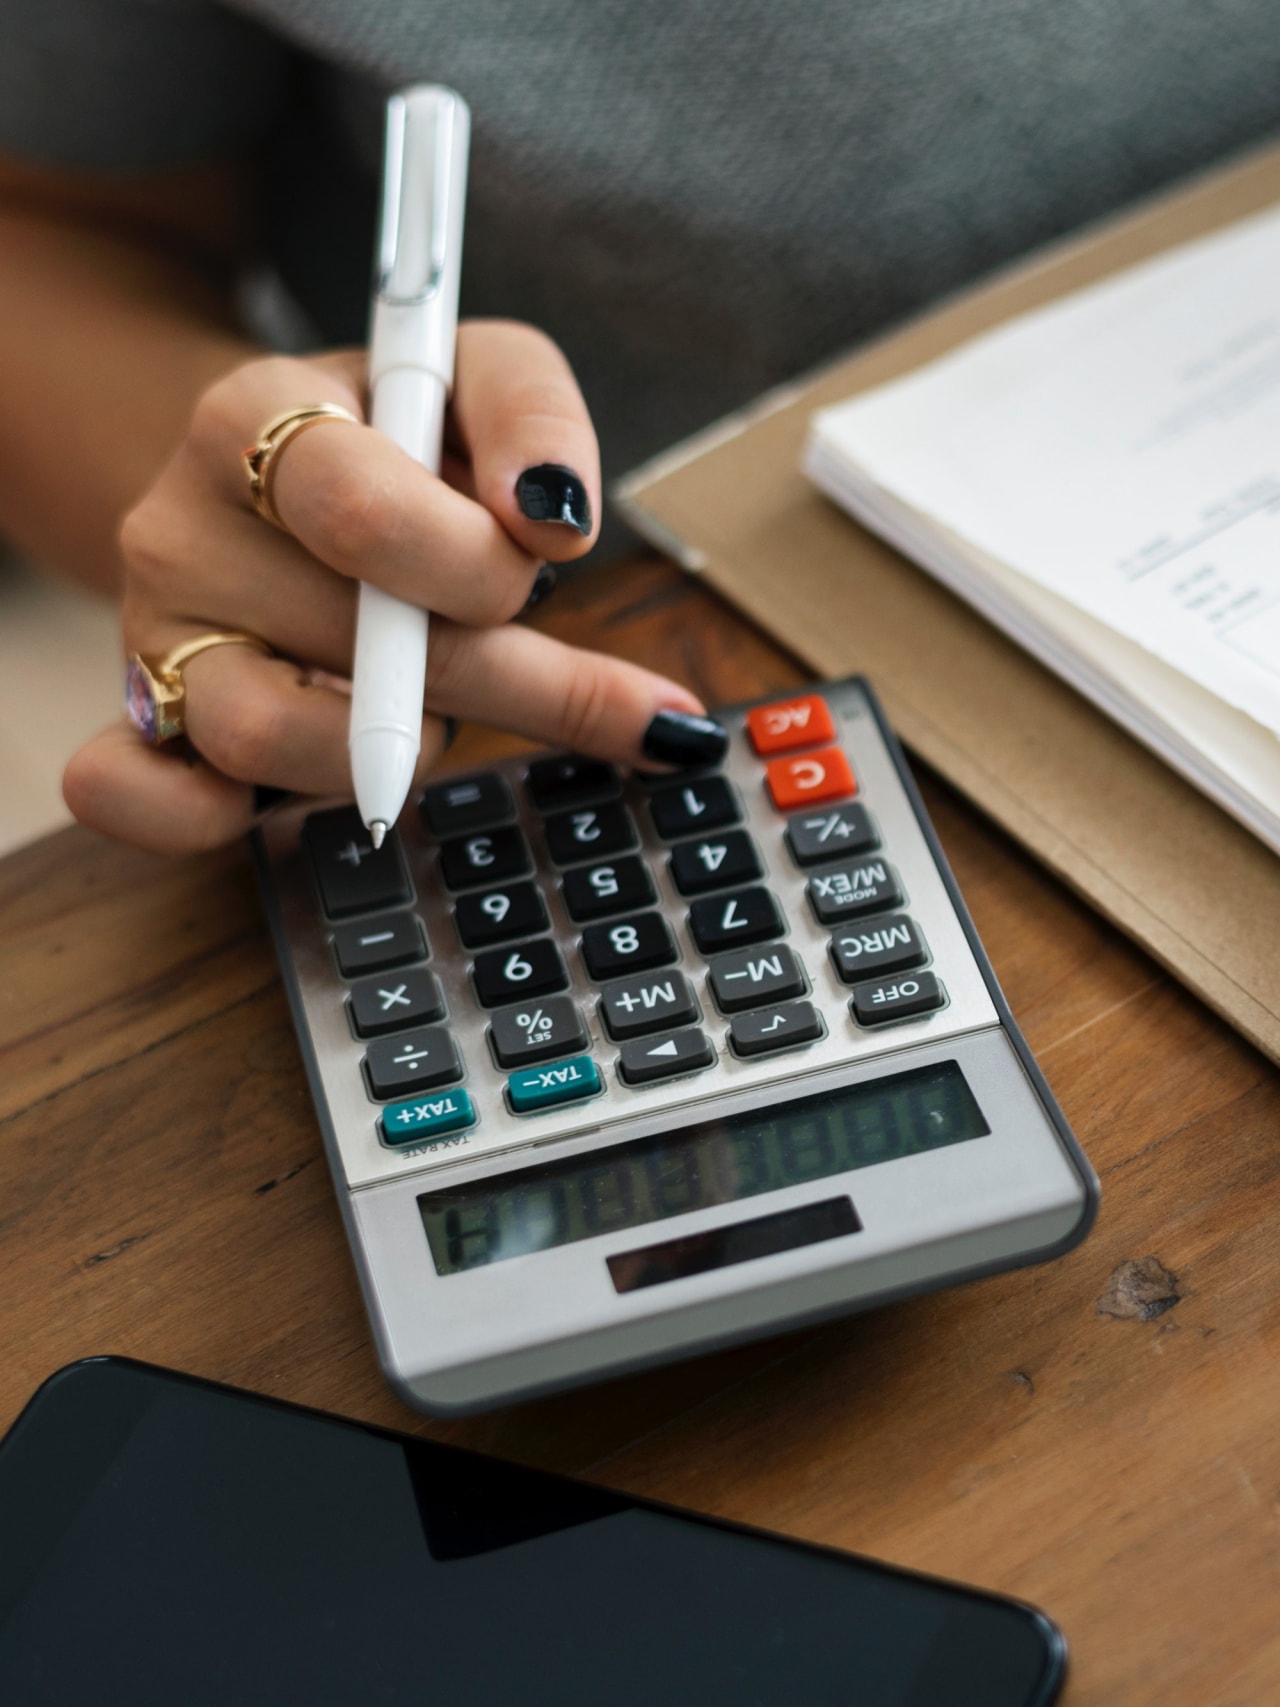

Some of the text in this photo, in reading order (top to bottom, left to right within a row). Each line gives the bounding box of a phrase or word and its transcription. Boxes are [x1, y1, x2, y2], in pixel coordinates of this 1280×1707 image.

[767, 705, 811, 735] AC
[790, 760, 825, 789] C
[683, 789, 705, 816] 1
[572, 812, 600, 842] 2
[466, 838, 495, 866] 3
[700, 844, 727, 871] 4
[590, 867, 619, 897] 5
[814, 863, 887, 899] M/EX
[482, 895, 510, 922] 6
[836, 887, 878, 905] MODE
[721, 901, 748, 930] 7
[610, 925, 639, 953] 8
[840, 924, 911, 958] MRC
[505, 953, 532, 981] 9
[615, 981, 677, 1012] M+
[871, 981, 919, 1004] OFF
[526, 1031, 552, 1045] SET
[396, 1097, 458, 1124] TAX+
[402, 1135, 471, 1160] TAX RATE
